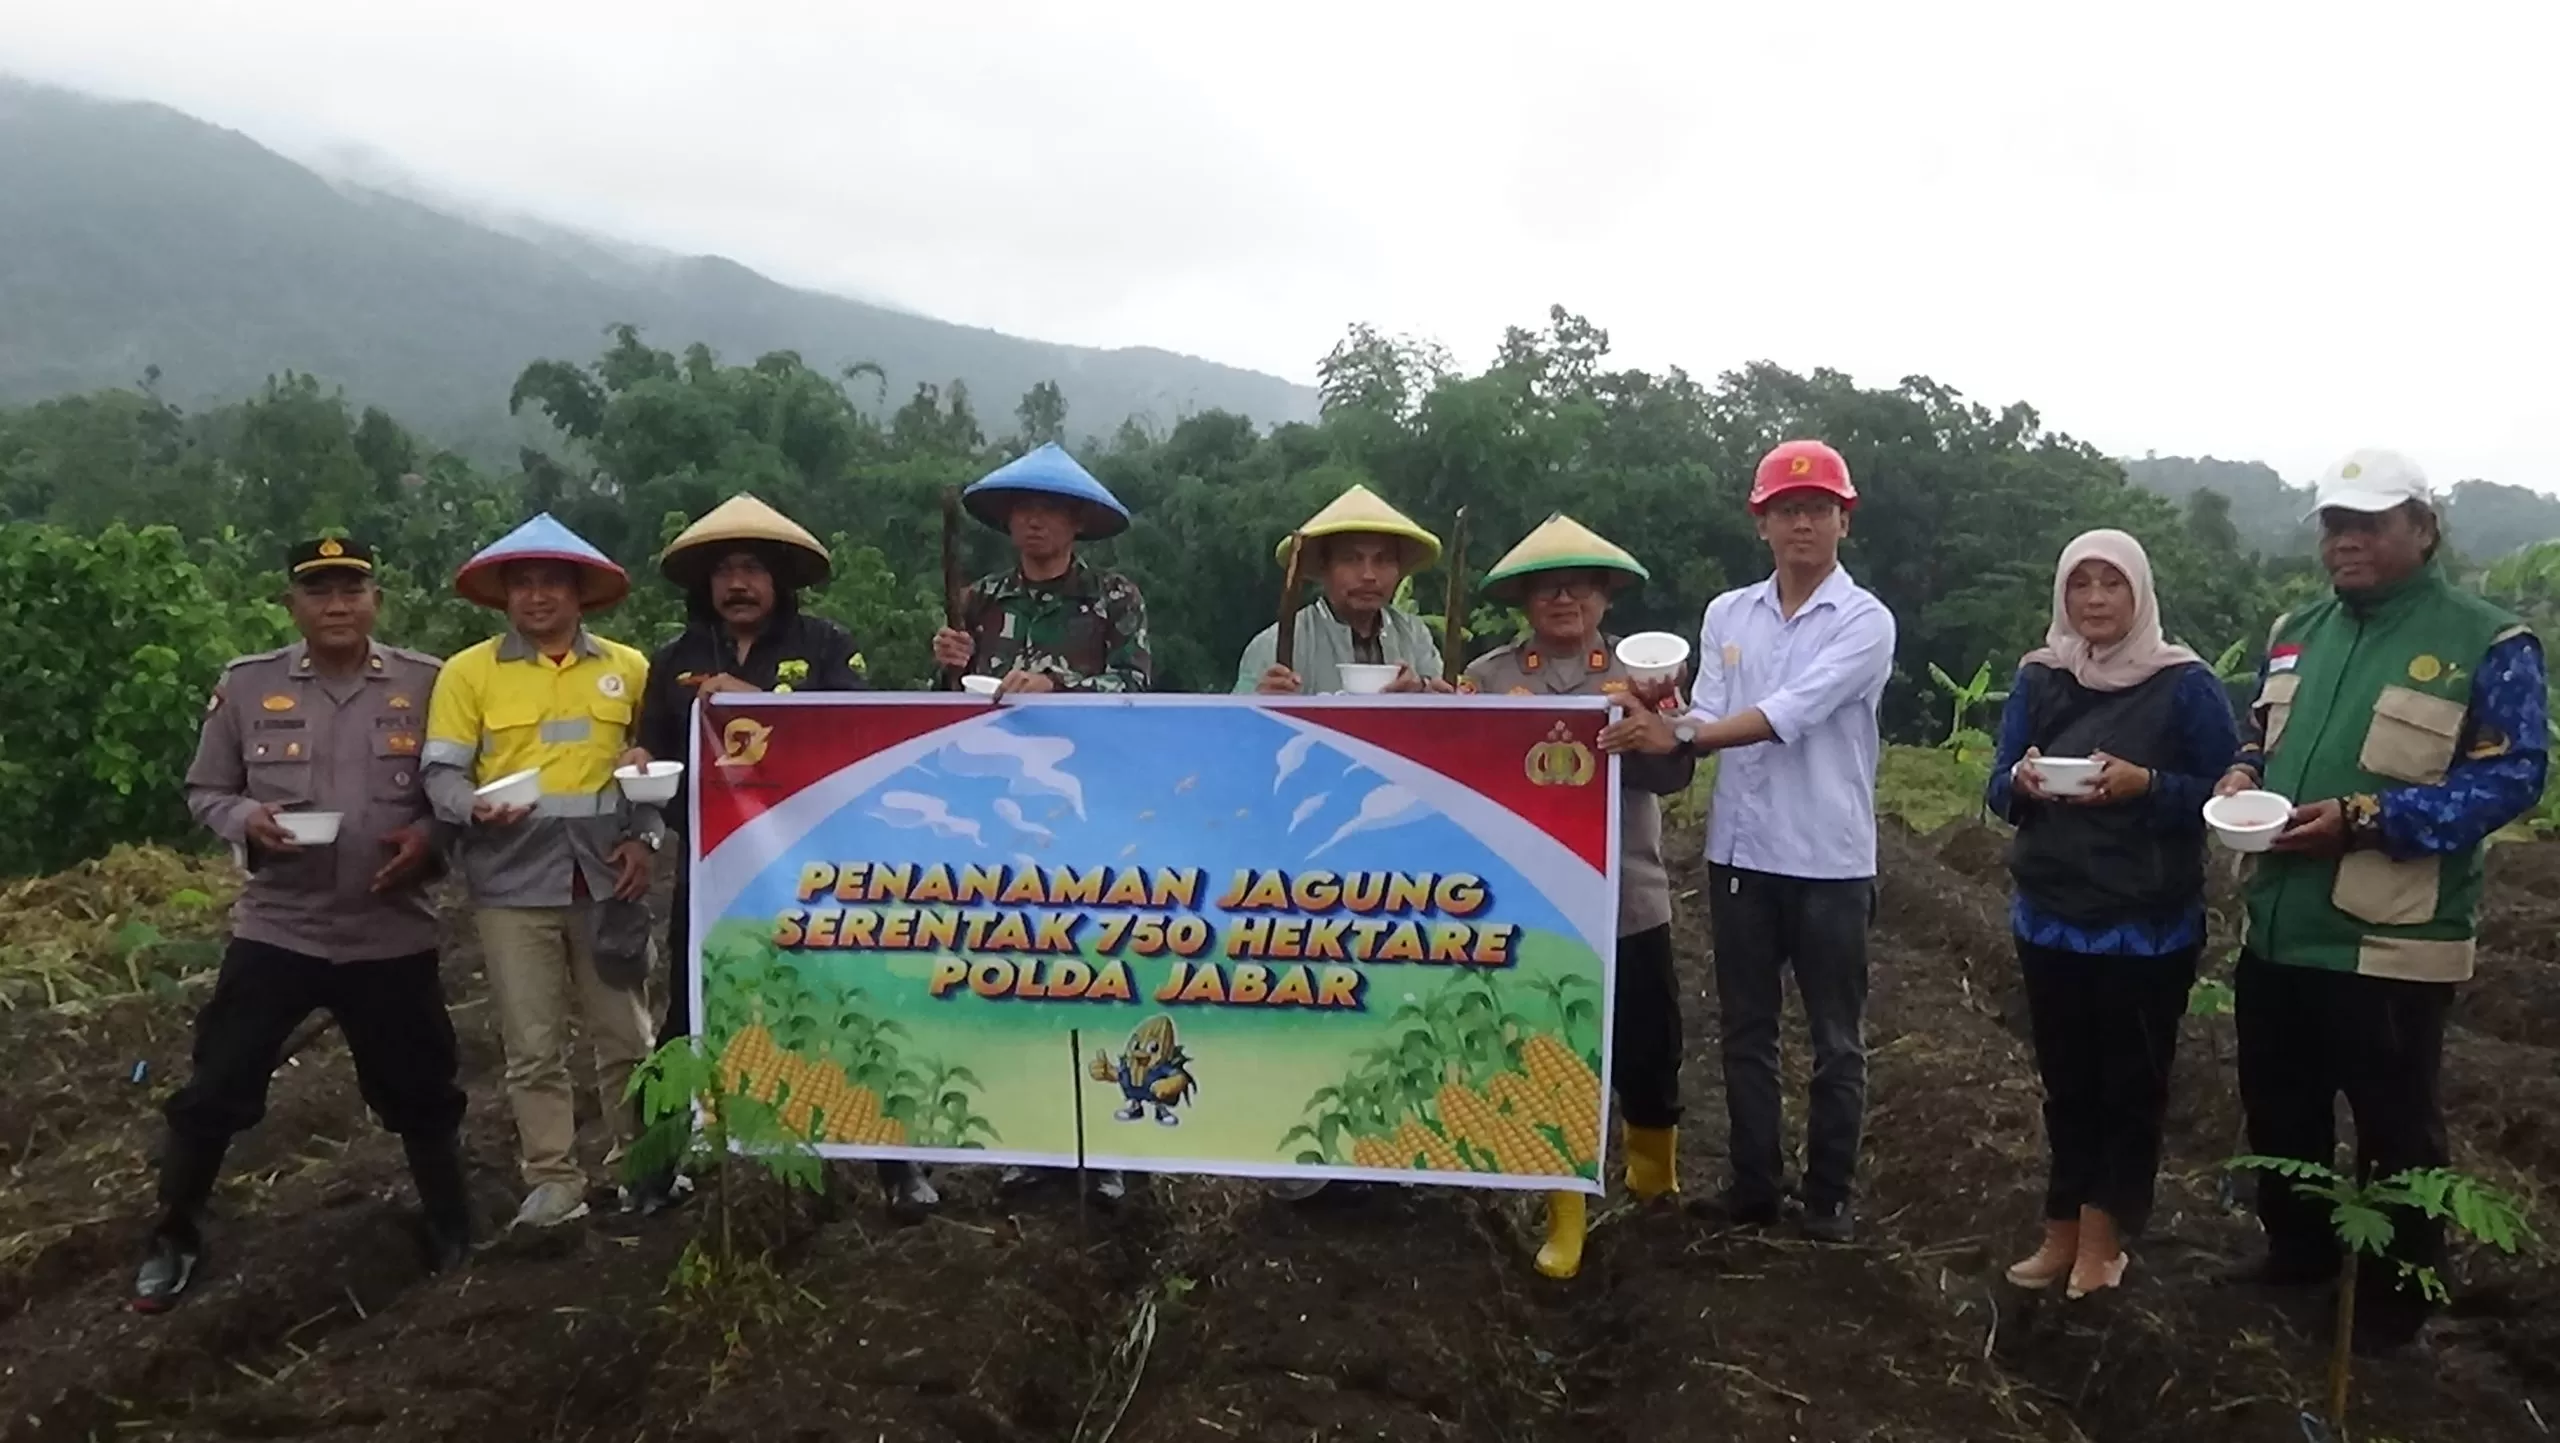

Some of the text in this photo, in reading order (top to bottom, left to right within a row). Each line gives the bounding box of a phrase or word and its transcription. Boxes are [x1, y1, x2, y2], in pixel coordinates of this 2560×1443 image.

[798, 860, 1490, 914] PENANAMAN JAGUNG
[772, 908, 1516, 965] SERENTAK 750 HEKTARE
[929, 955, 1364, 1007] POLDA JABAR
